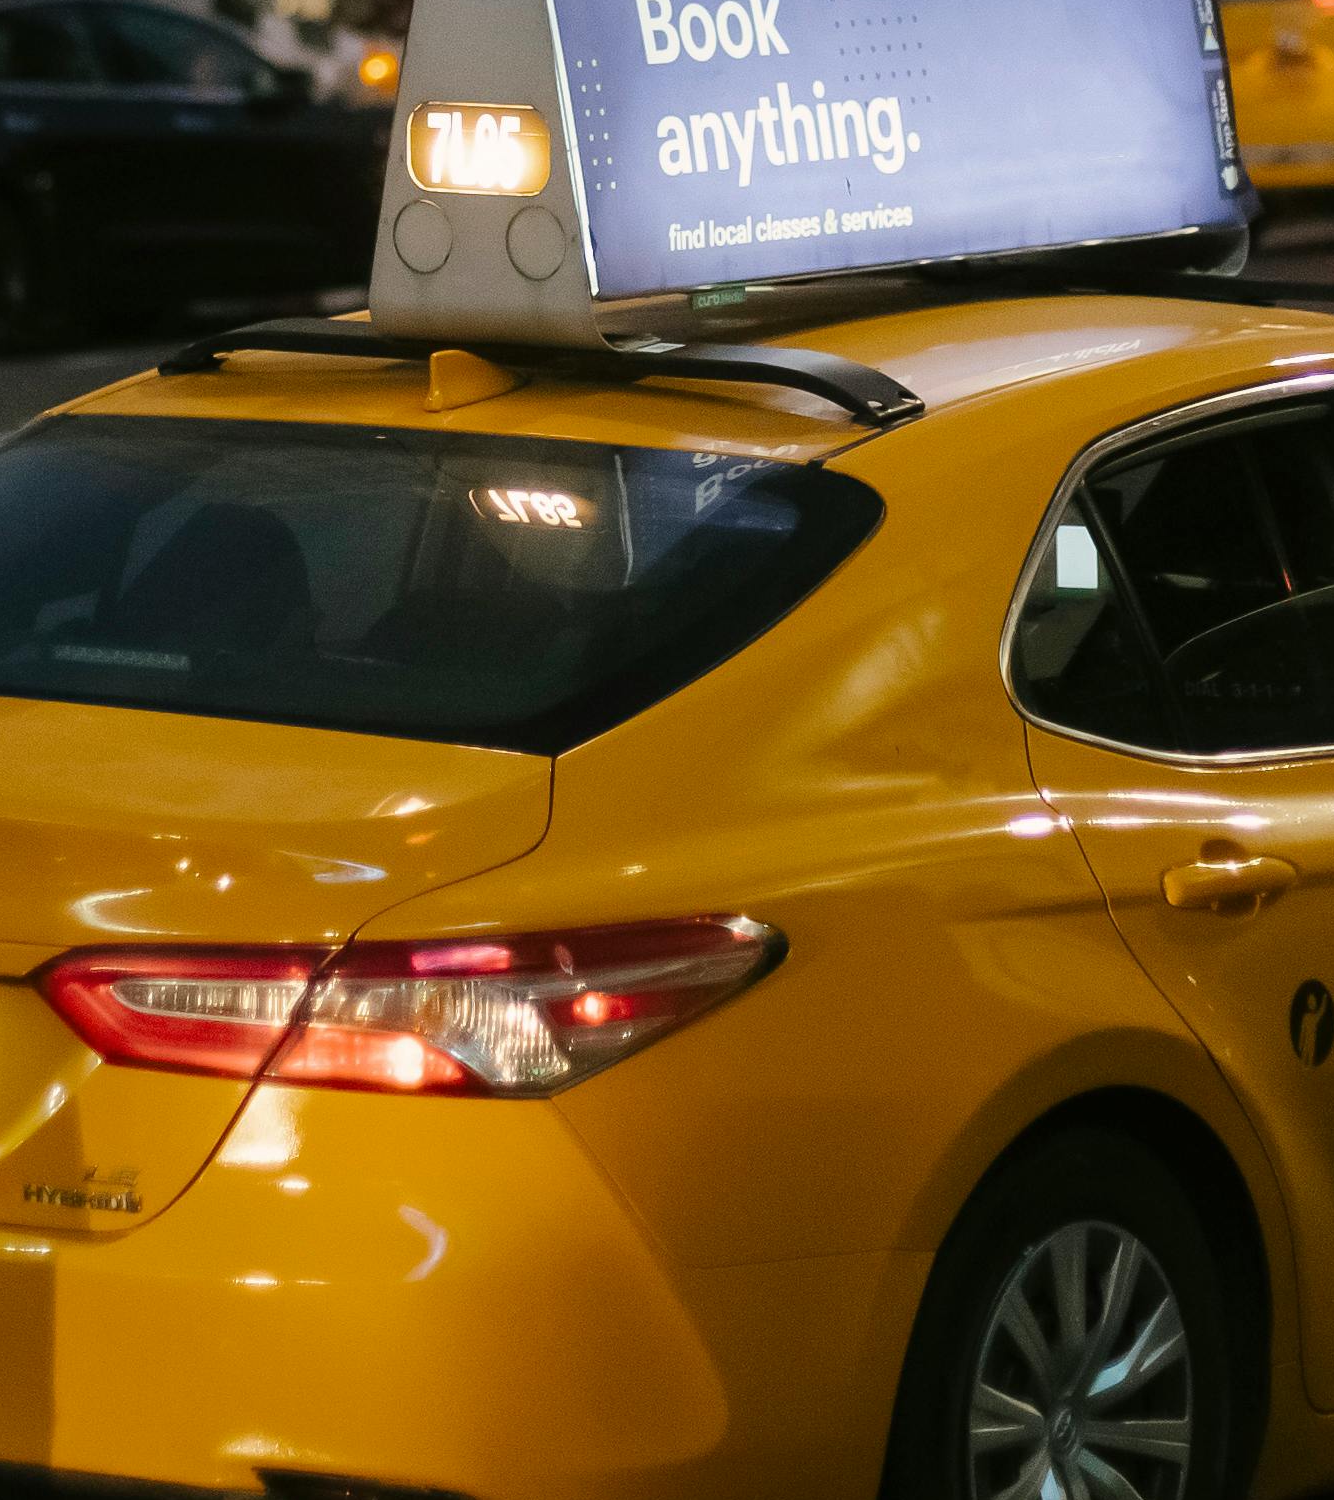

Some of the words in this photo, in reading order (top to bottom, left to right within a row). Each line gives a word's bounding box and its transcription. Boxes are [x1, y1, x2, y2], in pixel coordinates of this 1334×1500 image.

[656, 79, 922, 188] anything.
[668, 221, 706, 252] find
[709, 215, 753, 247] local
[755, 213, 822, 243] classes
[823, 208, 839, 235] &
[841, 202, 914, 233] services
